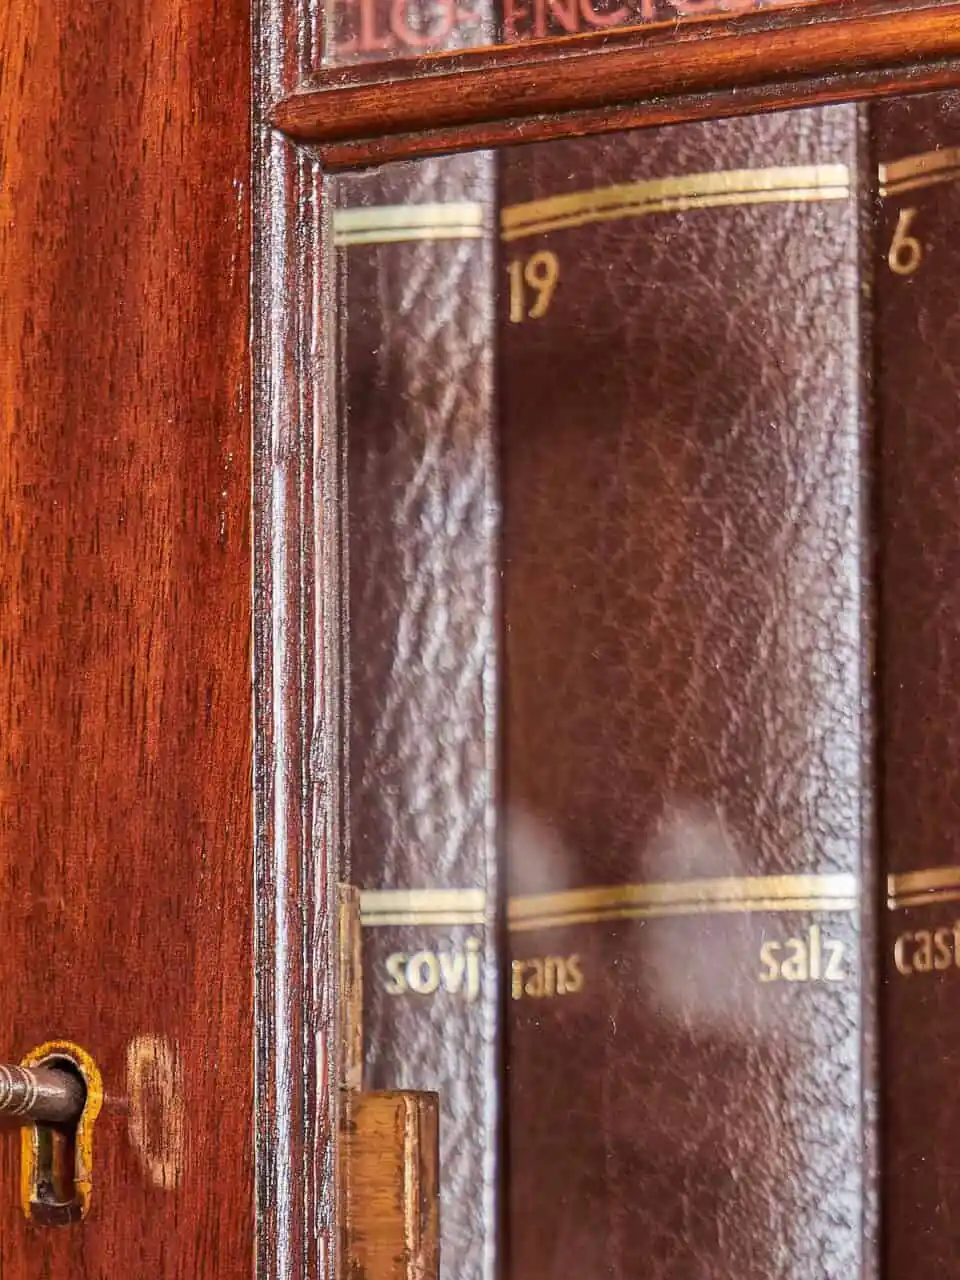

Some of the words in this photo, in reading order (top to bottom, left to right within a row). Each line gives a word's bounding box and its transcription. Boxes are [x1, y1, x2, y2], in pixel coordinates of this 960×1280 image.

[888, 207, 922, 275] 6
[507, 248, 560, 323] 19
[384, 937, 481, 1001] sovj
[511, 953, 584, 1000] rans
[759, 924, 846, 982] salz
